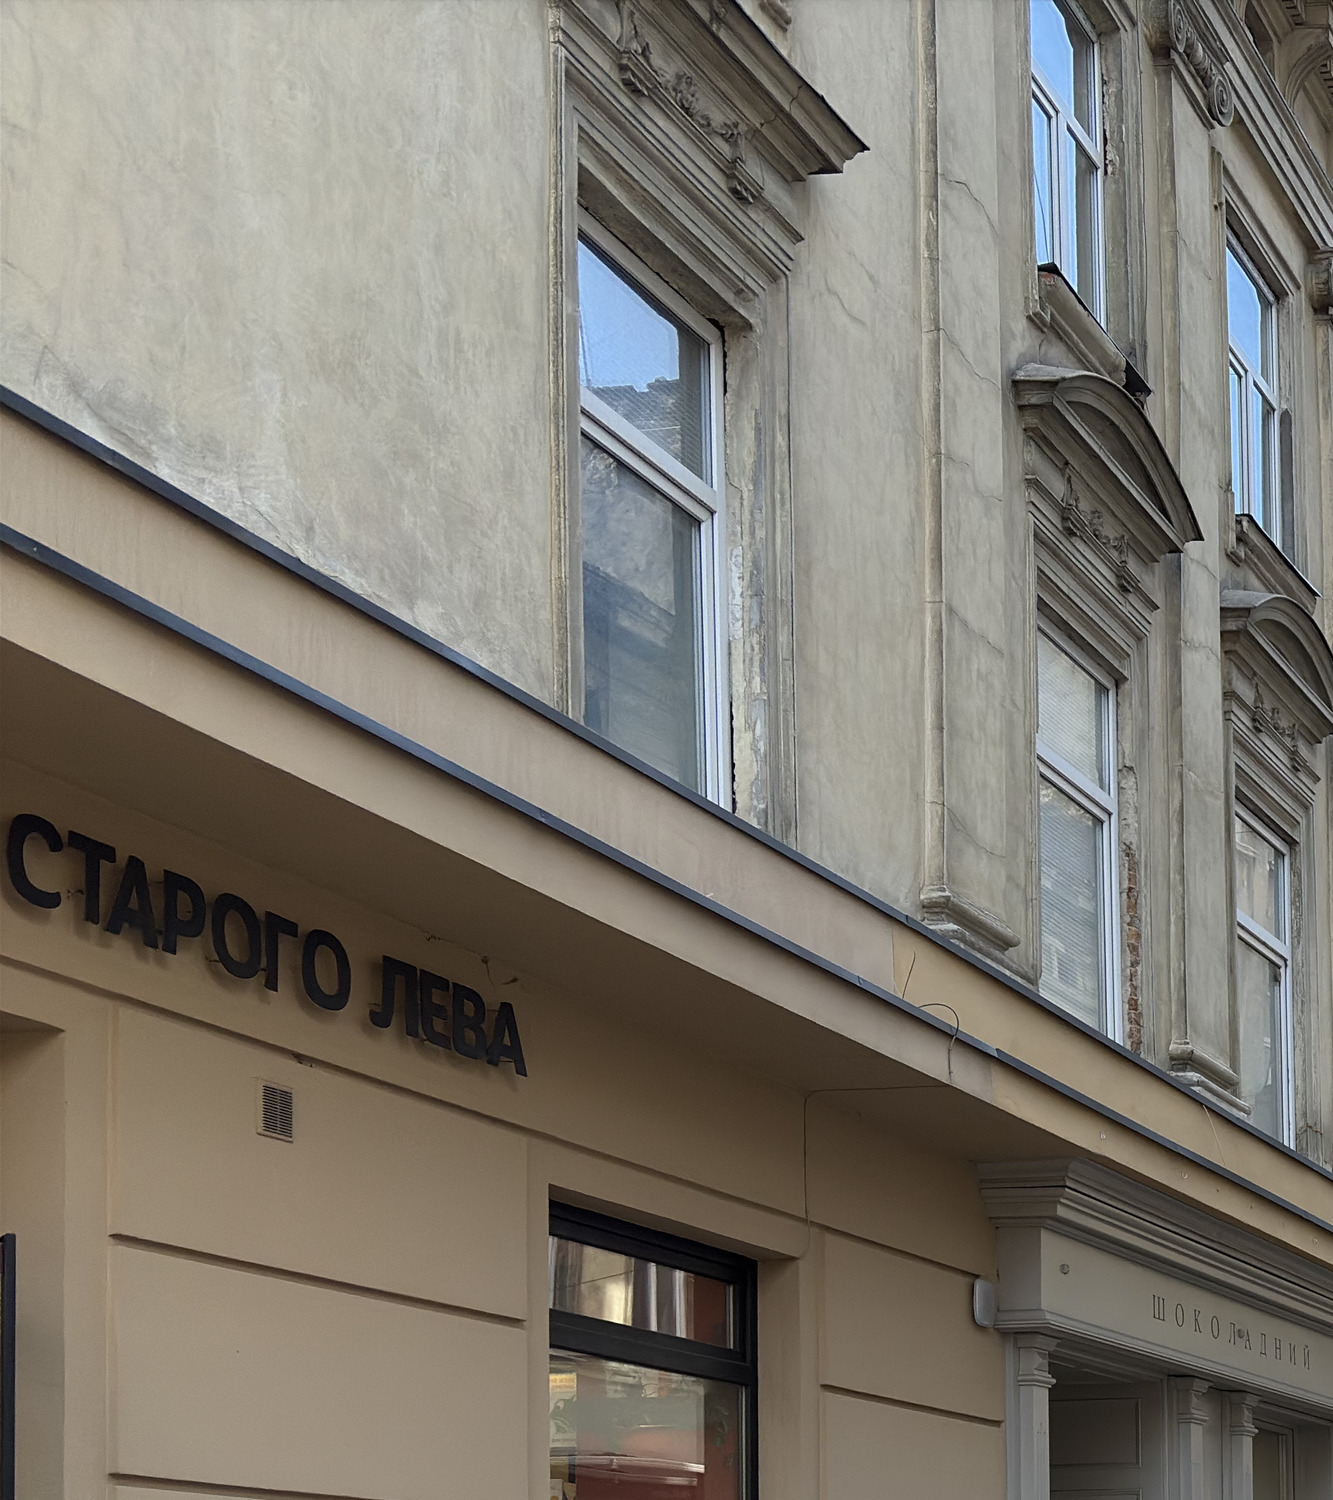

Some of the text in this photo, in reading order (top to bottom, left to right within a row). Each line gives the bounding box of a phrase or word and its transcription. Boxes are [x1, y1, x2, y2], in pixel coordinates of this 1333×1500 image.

[6, 813, 528, 1078] СТАРОГО ЛЕВА
[1152, 1294, 1310, 1370] ШОКОЛАДНИЙ
